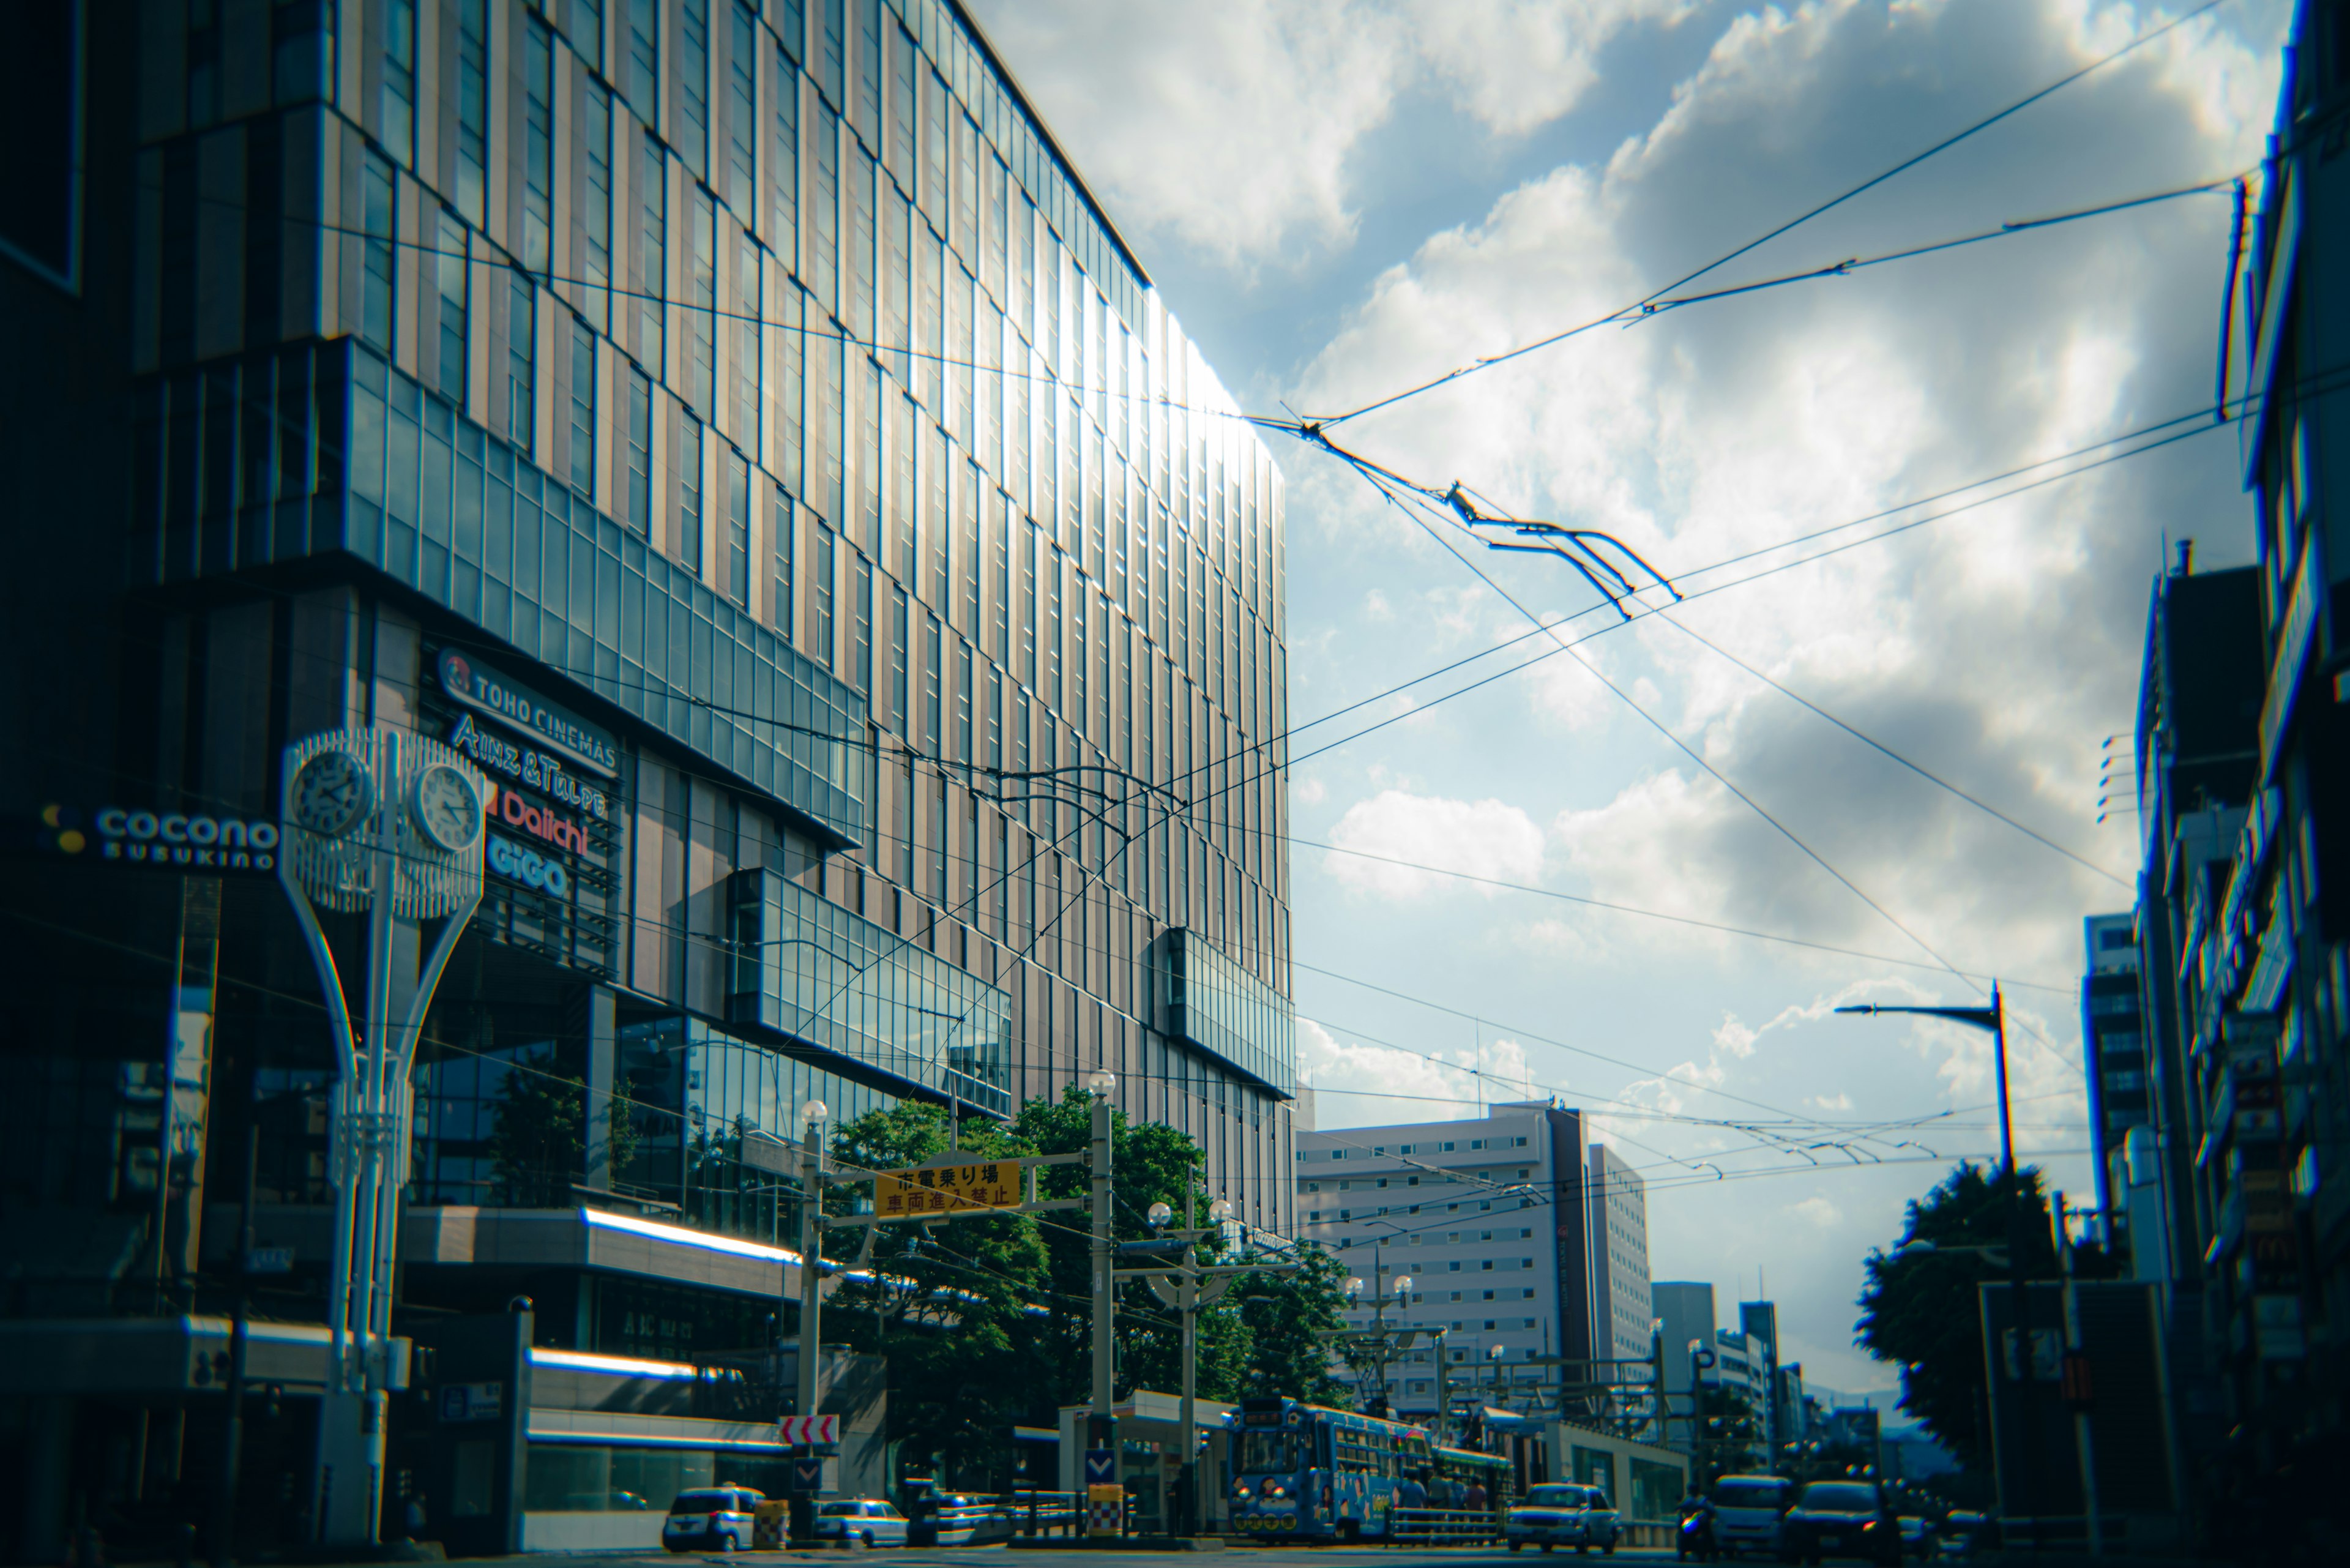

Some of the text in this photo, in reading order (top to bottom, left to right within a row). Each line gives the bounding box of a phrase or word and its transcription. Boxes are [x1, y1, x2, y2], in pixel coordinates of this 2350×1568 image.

[453, 714, 521, 776] AINZ
[477, 675, 615, 768] TOHO CINEMAS
[504, 791, 589, 856] Daiichi
[886, 1185, 1010, 1214] 車両進入禁止
[897, 1164, 999, 1192] 市電乗り場
